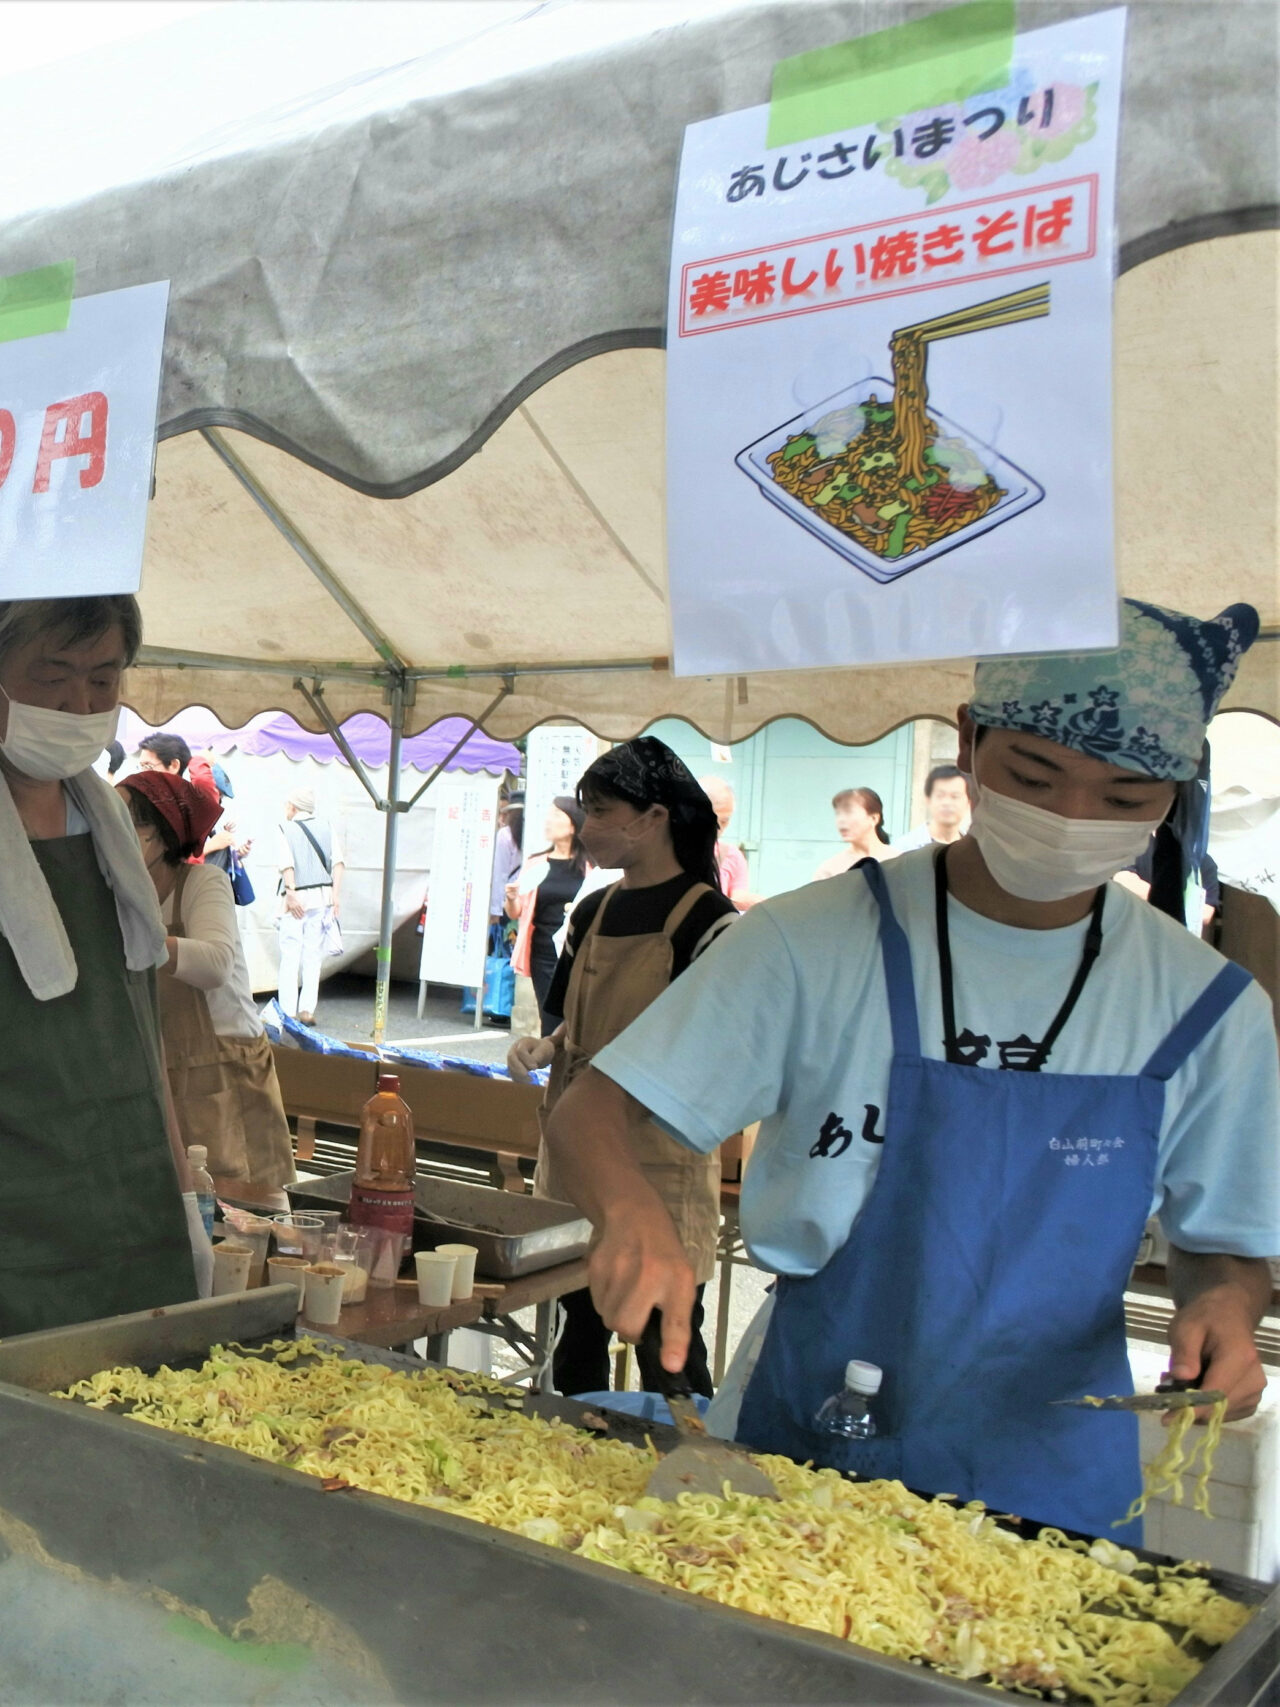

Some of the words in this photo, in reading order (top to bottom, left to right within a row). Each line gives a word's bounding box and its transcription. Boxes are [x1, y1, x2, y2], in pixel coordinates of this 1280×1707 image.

[726, 88, 1055, 203] あじさいまつり
[690, 196, 1075, 315] 美味しい焼きそば
